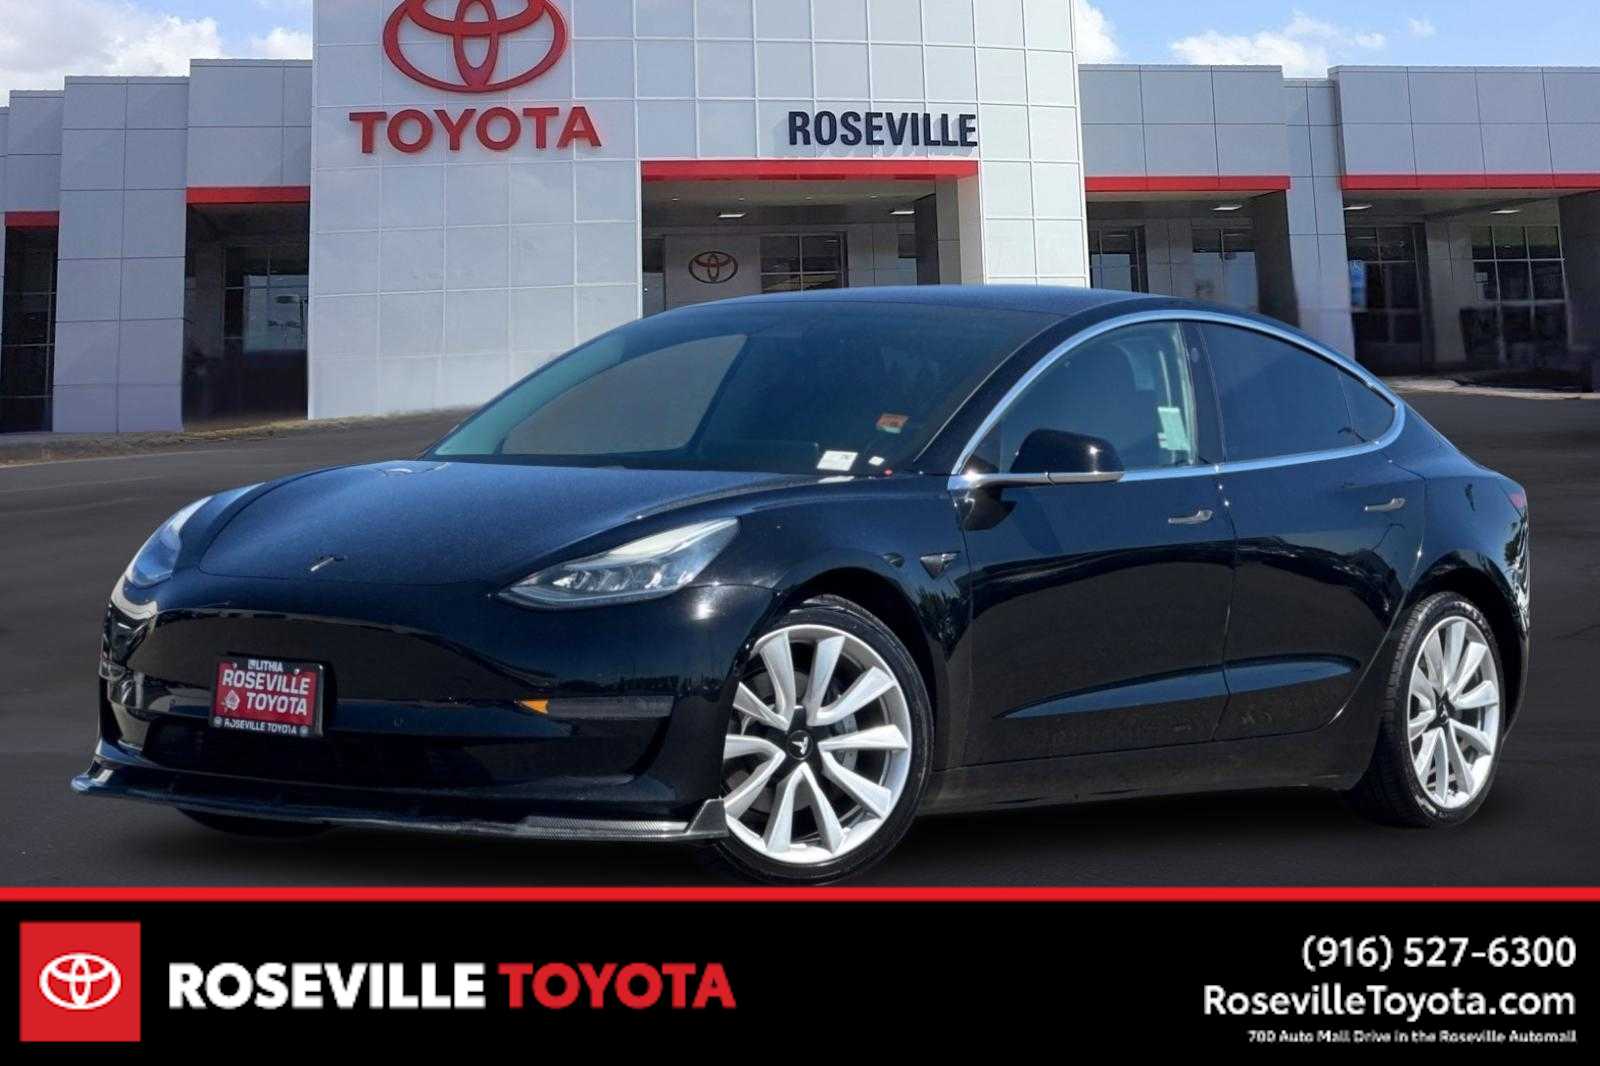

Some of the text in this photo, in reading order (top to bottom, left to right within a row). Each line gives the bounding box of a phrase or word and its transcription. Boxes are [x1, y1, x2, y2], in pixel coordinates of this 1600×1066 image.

[349, 106, 602, 154] TOYOTA
[788, 111, 979, 147] ROSEVILLE
[255, 659, 284, 672] LITHIA
[222, 669, 311, 695] ROSEVILLE
[246, 691, 308, 716] TOYOTA
[267, 722, 297, 735] TOYOTA
